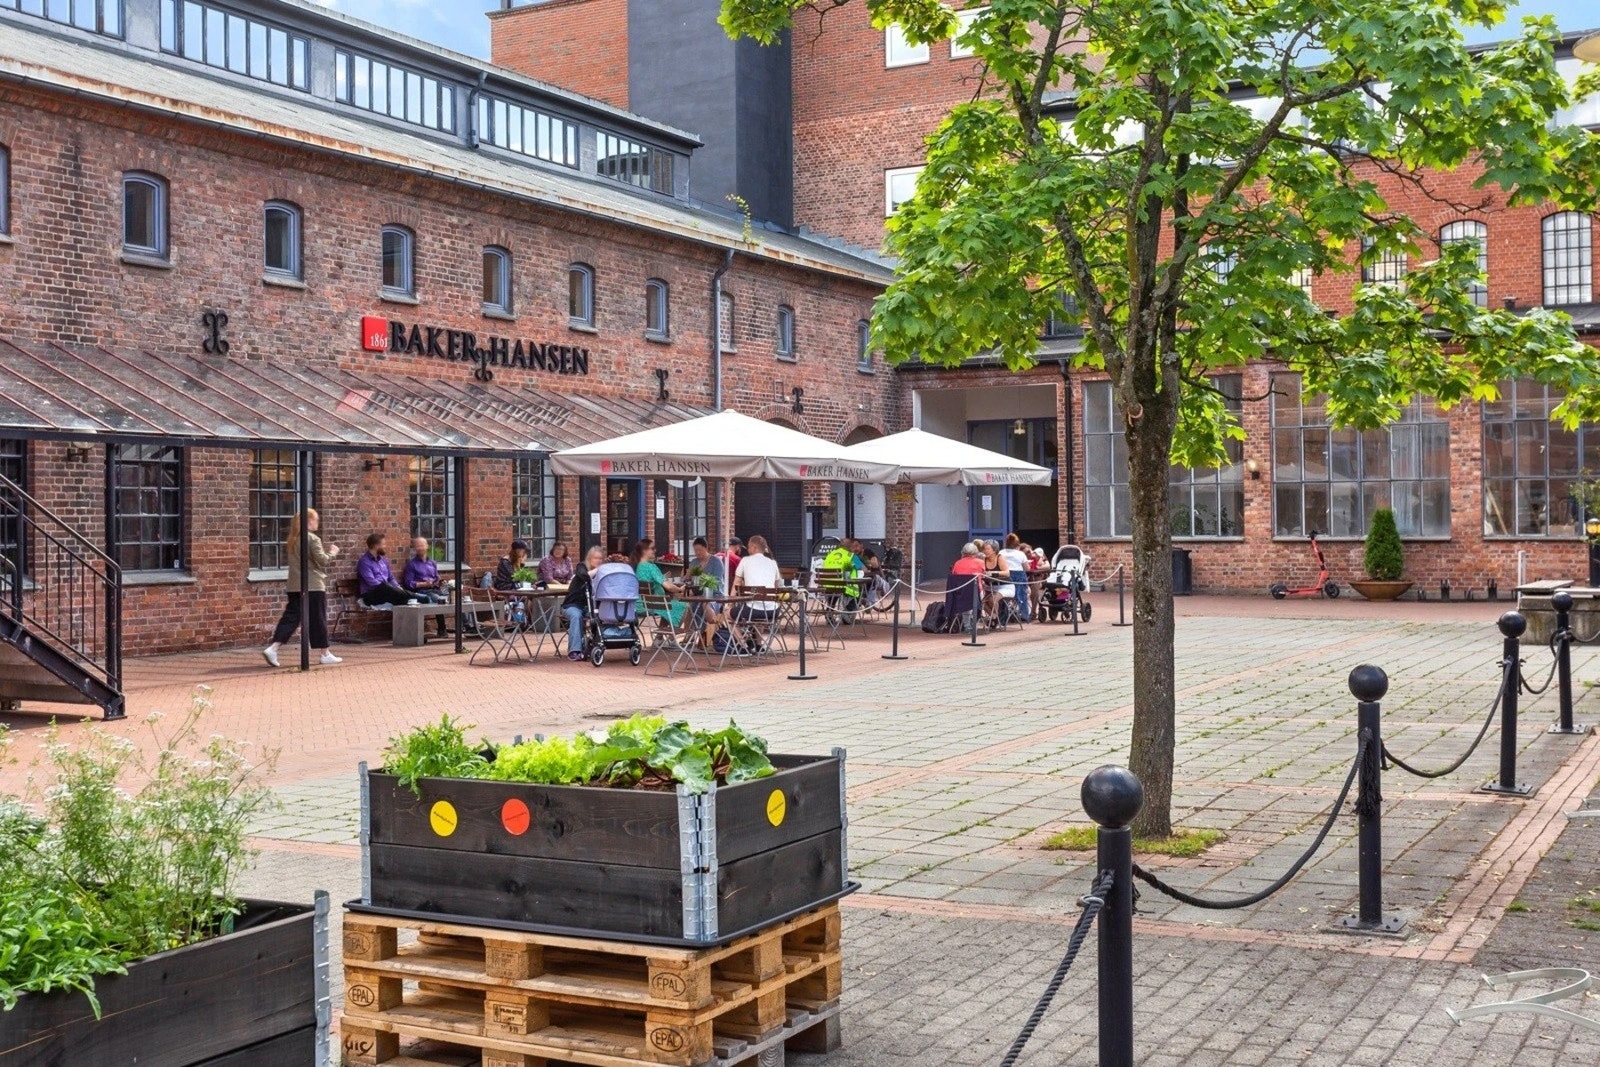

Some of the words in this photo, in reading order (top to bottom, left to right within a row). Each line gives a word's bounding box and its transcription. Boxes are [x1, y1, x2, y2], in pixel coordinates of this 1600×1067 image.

[370, 334, 388, 348] 1861
[390, 321, 479, 363] BAKER
[489, 336, 589, 375] HANSEN
[613, 460, 651, 473] BAKER
[657, 460, 711, 473] HANSEN
[807, 465, 834, 477] BAKER
[836, 465, 870, 479] HANSEN
[991, 473, 1009, 482] BAKER
[352, 988, 370, 1004] EPAL
[655, 1031, 679, 1048] EPAL
